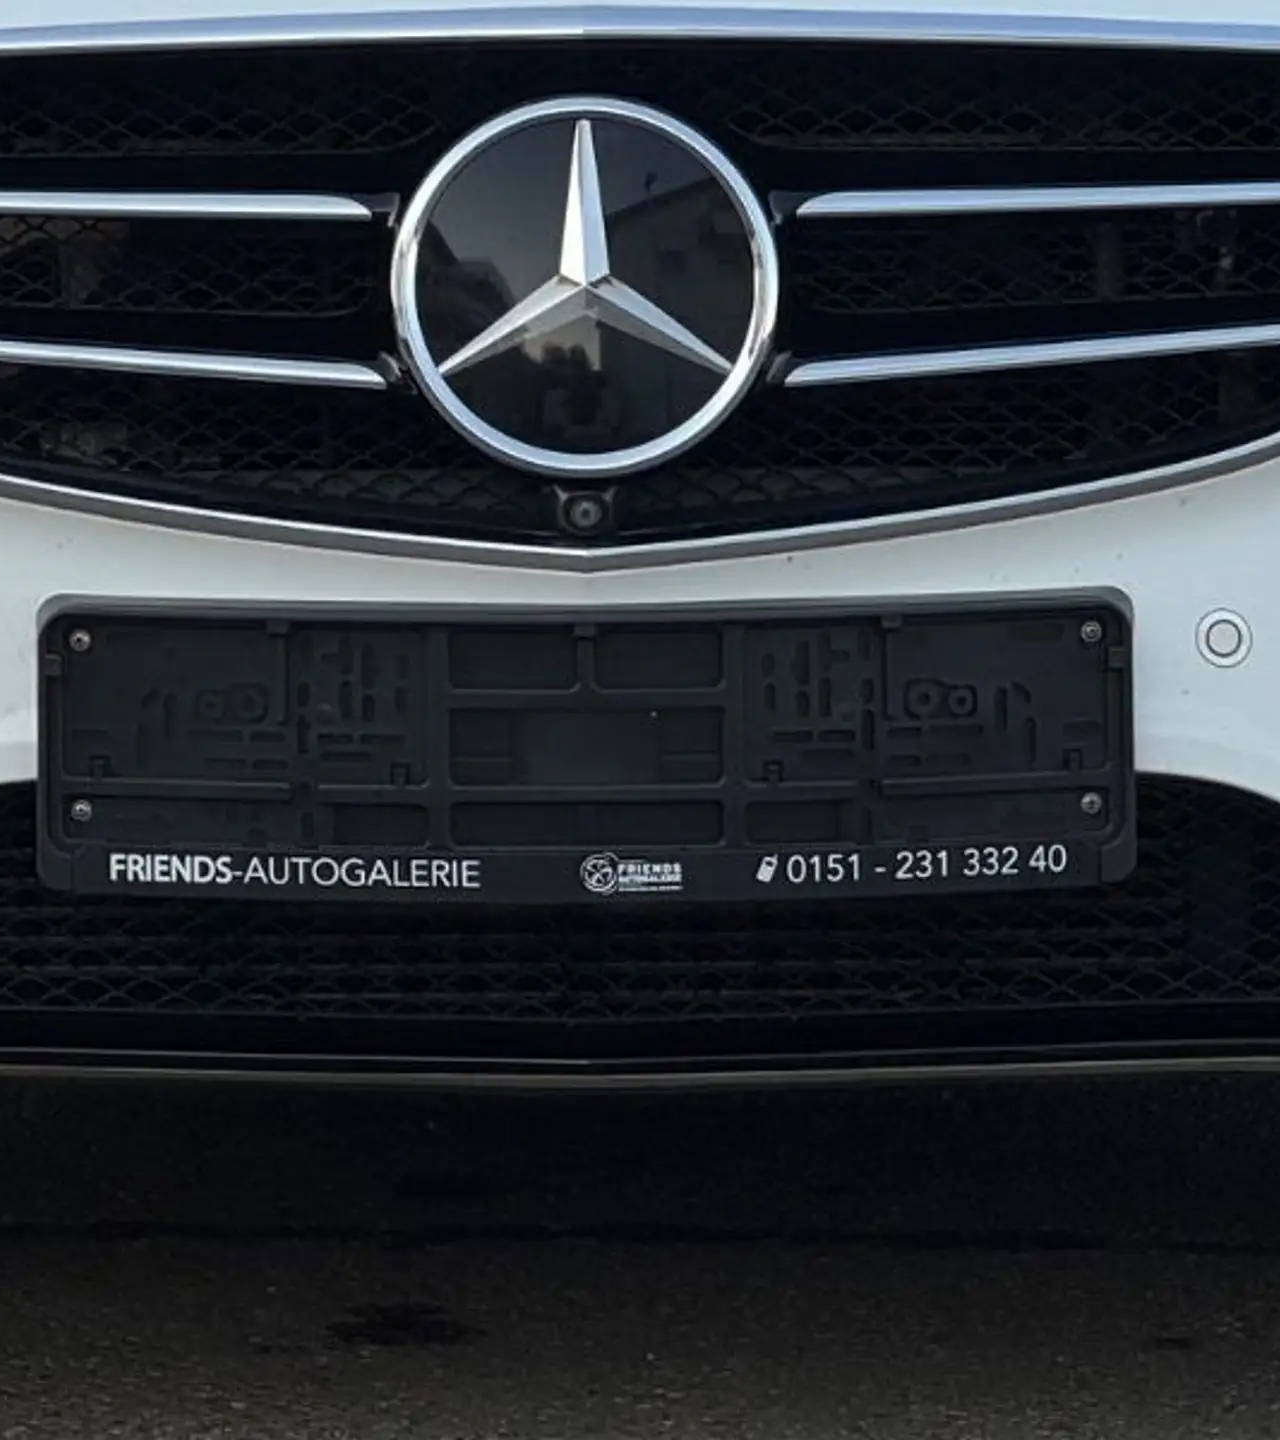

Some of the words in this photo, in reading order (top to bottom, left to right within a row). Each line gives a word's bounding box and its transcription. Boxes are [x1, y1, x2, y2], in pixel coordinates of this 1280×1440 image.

[109, 853, 481, 888] FRIENDS-AUTOGALERIE
[786, 853, 860, 883] 0151
[894, 849, 949, 880] 231
[962, 846, 1020, 877] 332
[1028, 844, 1068, 873] 40
